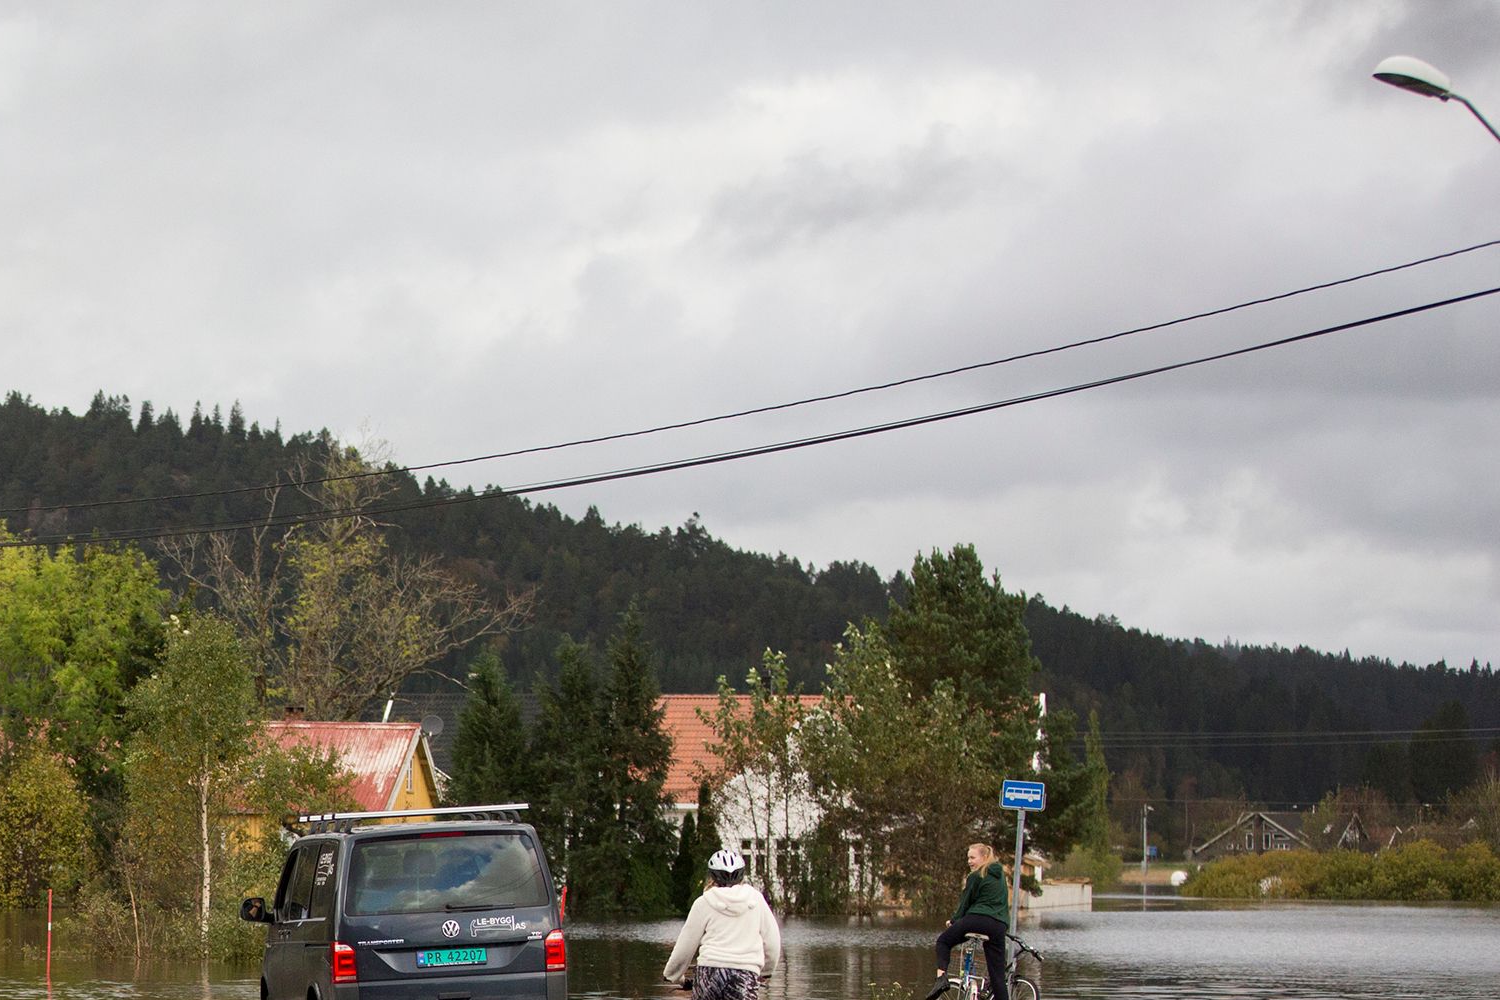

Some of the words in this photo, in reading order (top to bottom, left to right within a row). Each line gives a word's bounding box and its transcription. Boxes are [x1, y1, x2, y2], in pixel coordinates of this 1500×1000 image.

[476, 917, 512, 925] LE-BYGG
[516, 922, 526, 930] AS
[427, 952, 442, 963] PR
[447, 950, 483, 961] 42207
